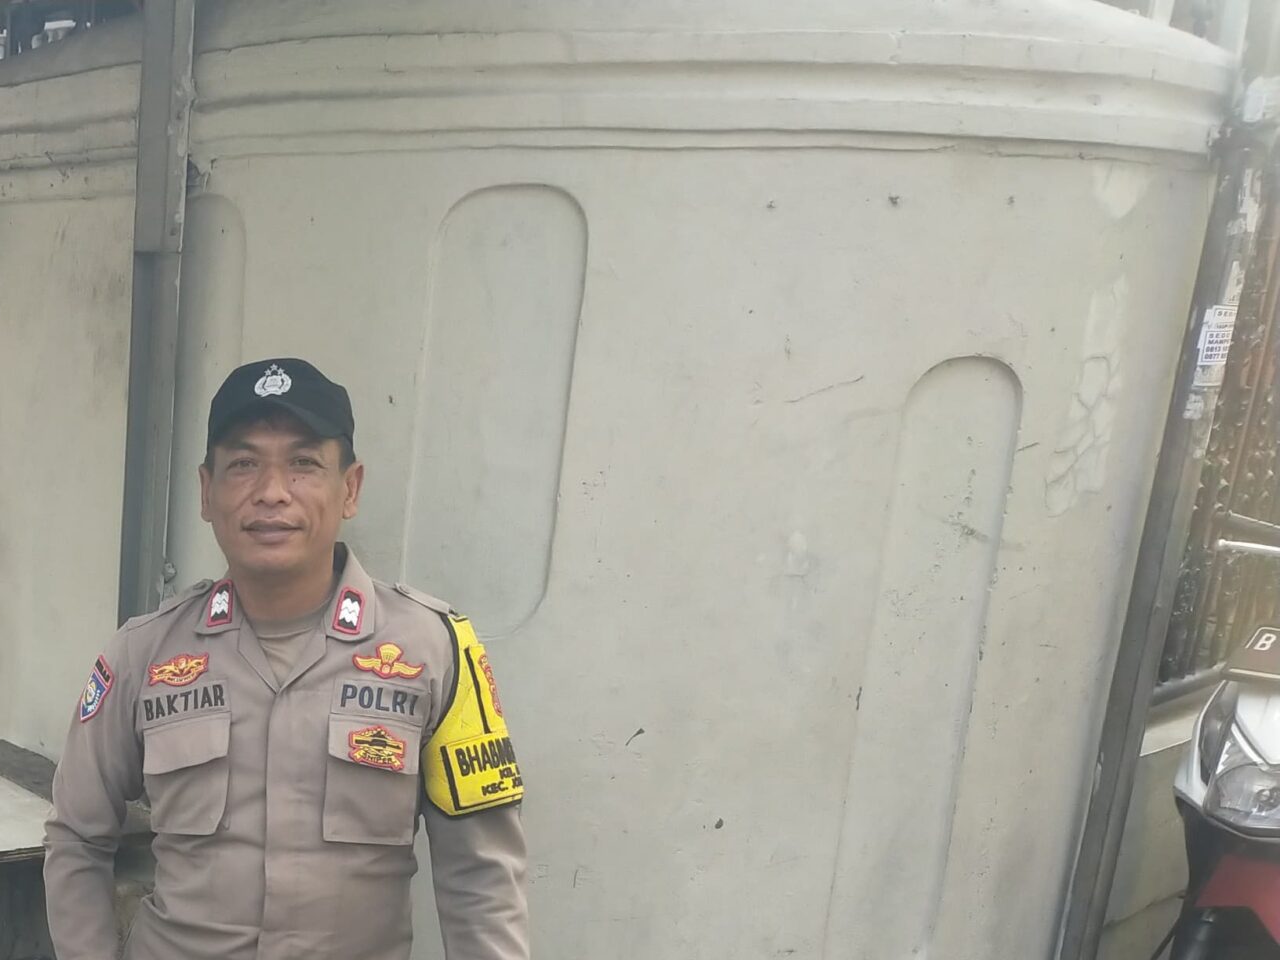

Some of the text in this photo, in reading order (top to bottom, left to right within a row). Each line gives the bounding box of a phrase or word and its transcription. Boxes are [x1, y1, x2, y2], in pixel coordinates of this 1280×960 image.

[1253, 633, 1277, 650] B
[143, 684, 225, 721] BAKTIAR
[340, 684, 419, 716] POLRI
